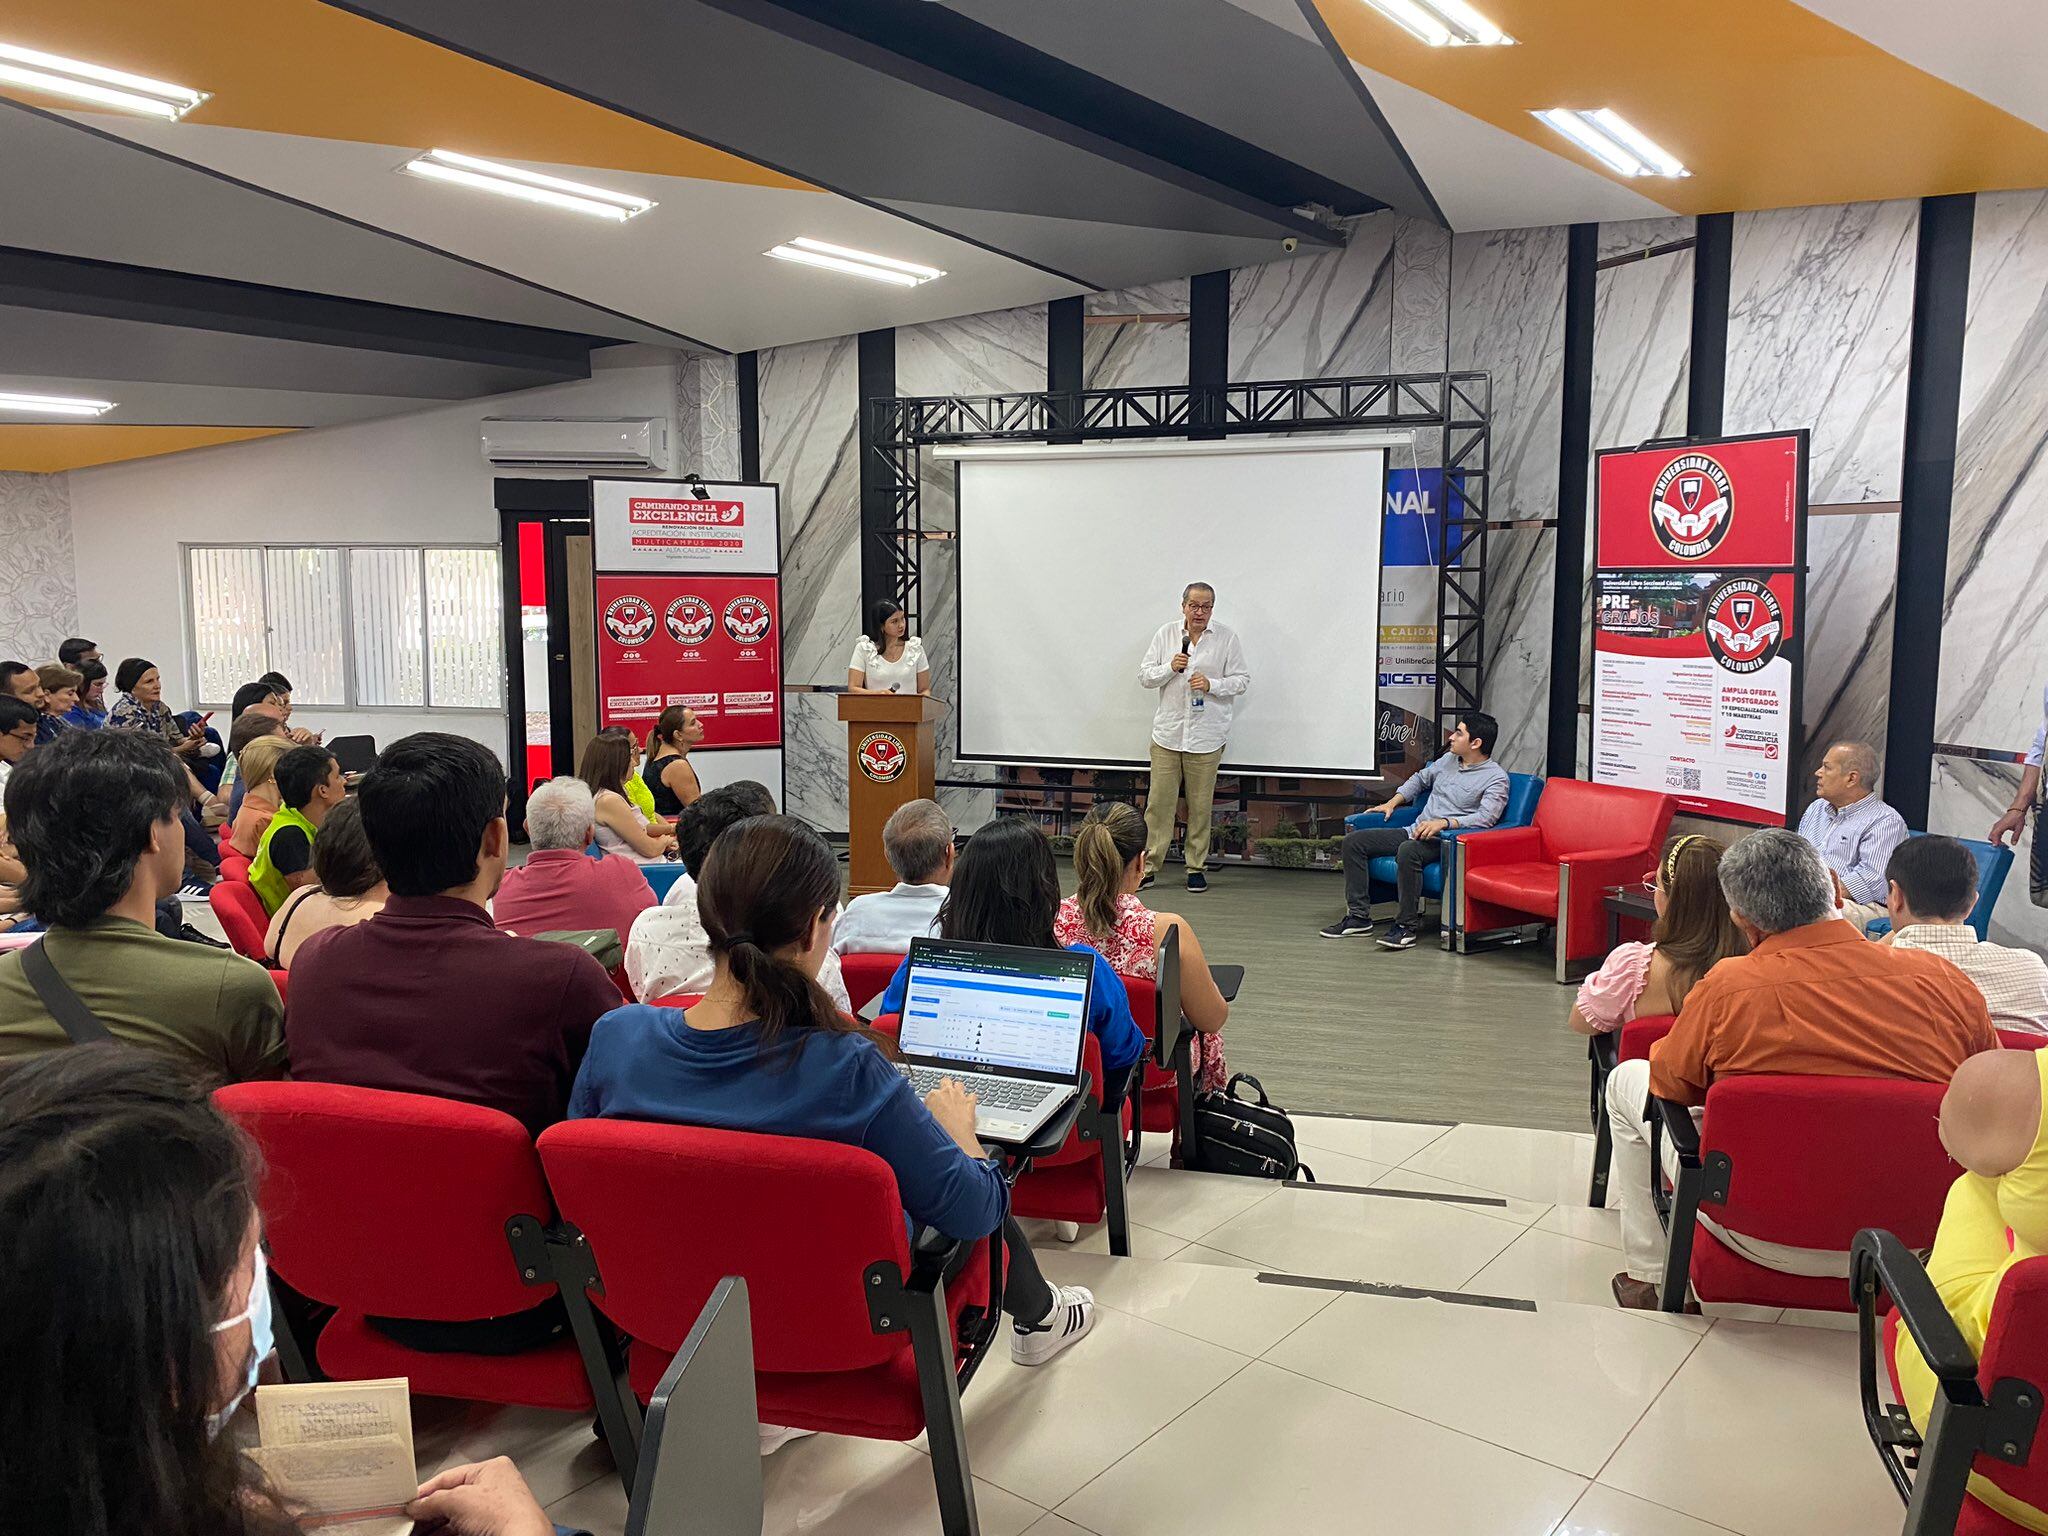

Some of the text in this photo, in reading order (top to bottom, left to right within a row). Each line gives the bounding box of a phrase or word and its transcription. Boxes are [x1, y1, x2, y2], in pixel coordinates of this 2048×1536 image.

[1654, 457, 1730, 497] UNIVERSIDAD LIBRE
[634, 502, 690, 511] CAMINANDO
[706, 504, 717, 512] LA
[632, 510, 718, 522] EXCELENCIA
[635, 538, 704, 546] MULTICAMPUS
[1668, 538, 1712, 556] COLOMBIA
[1602, 594, 1630, 609] PRE
[1708, 581, 1780, 616] UNIVERSIDAD LIBRE
[1602, 610, 1660, 627] GRADOS
[618, 636, 644, 644] COLOMBIA
[678, 635, 703, 644] COLOMBIA
[735, 635, 760, 643] COLOMBIA
[1720, 656, 1764, 672] COLOMBIA
[1750, 689, 1776, 697] OFERTA
[1732, 697, 1778, 706] POSTGRADOS
[1729, 706, 1778, 714] ESPECIALIZACIONES
[1736, 733, 1778, 743] EXCELENCIA
